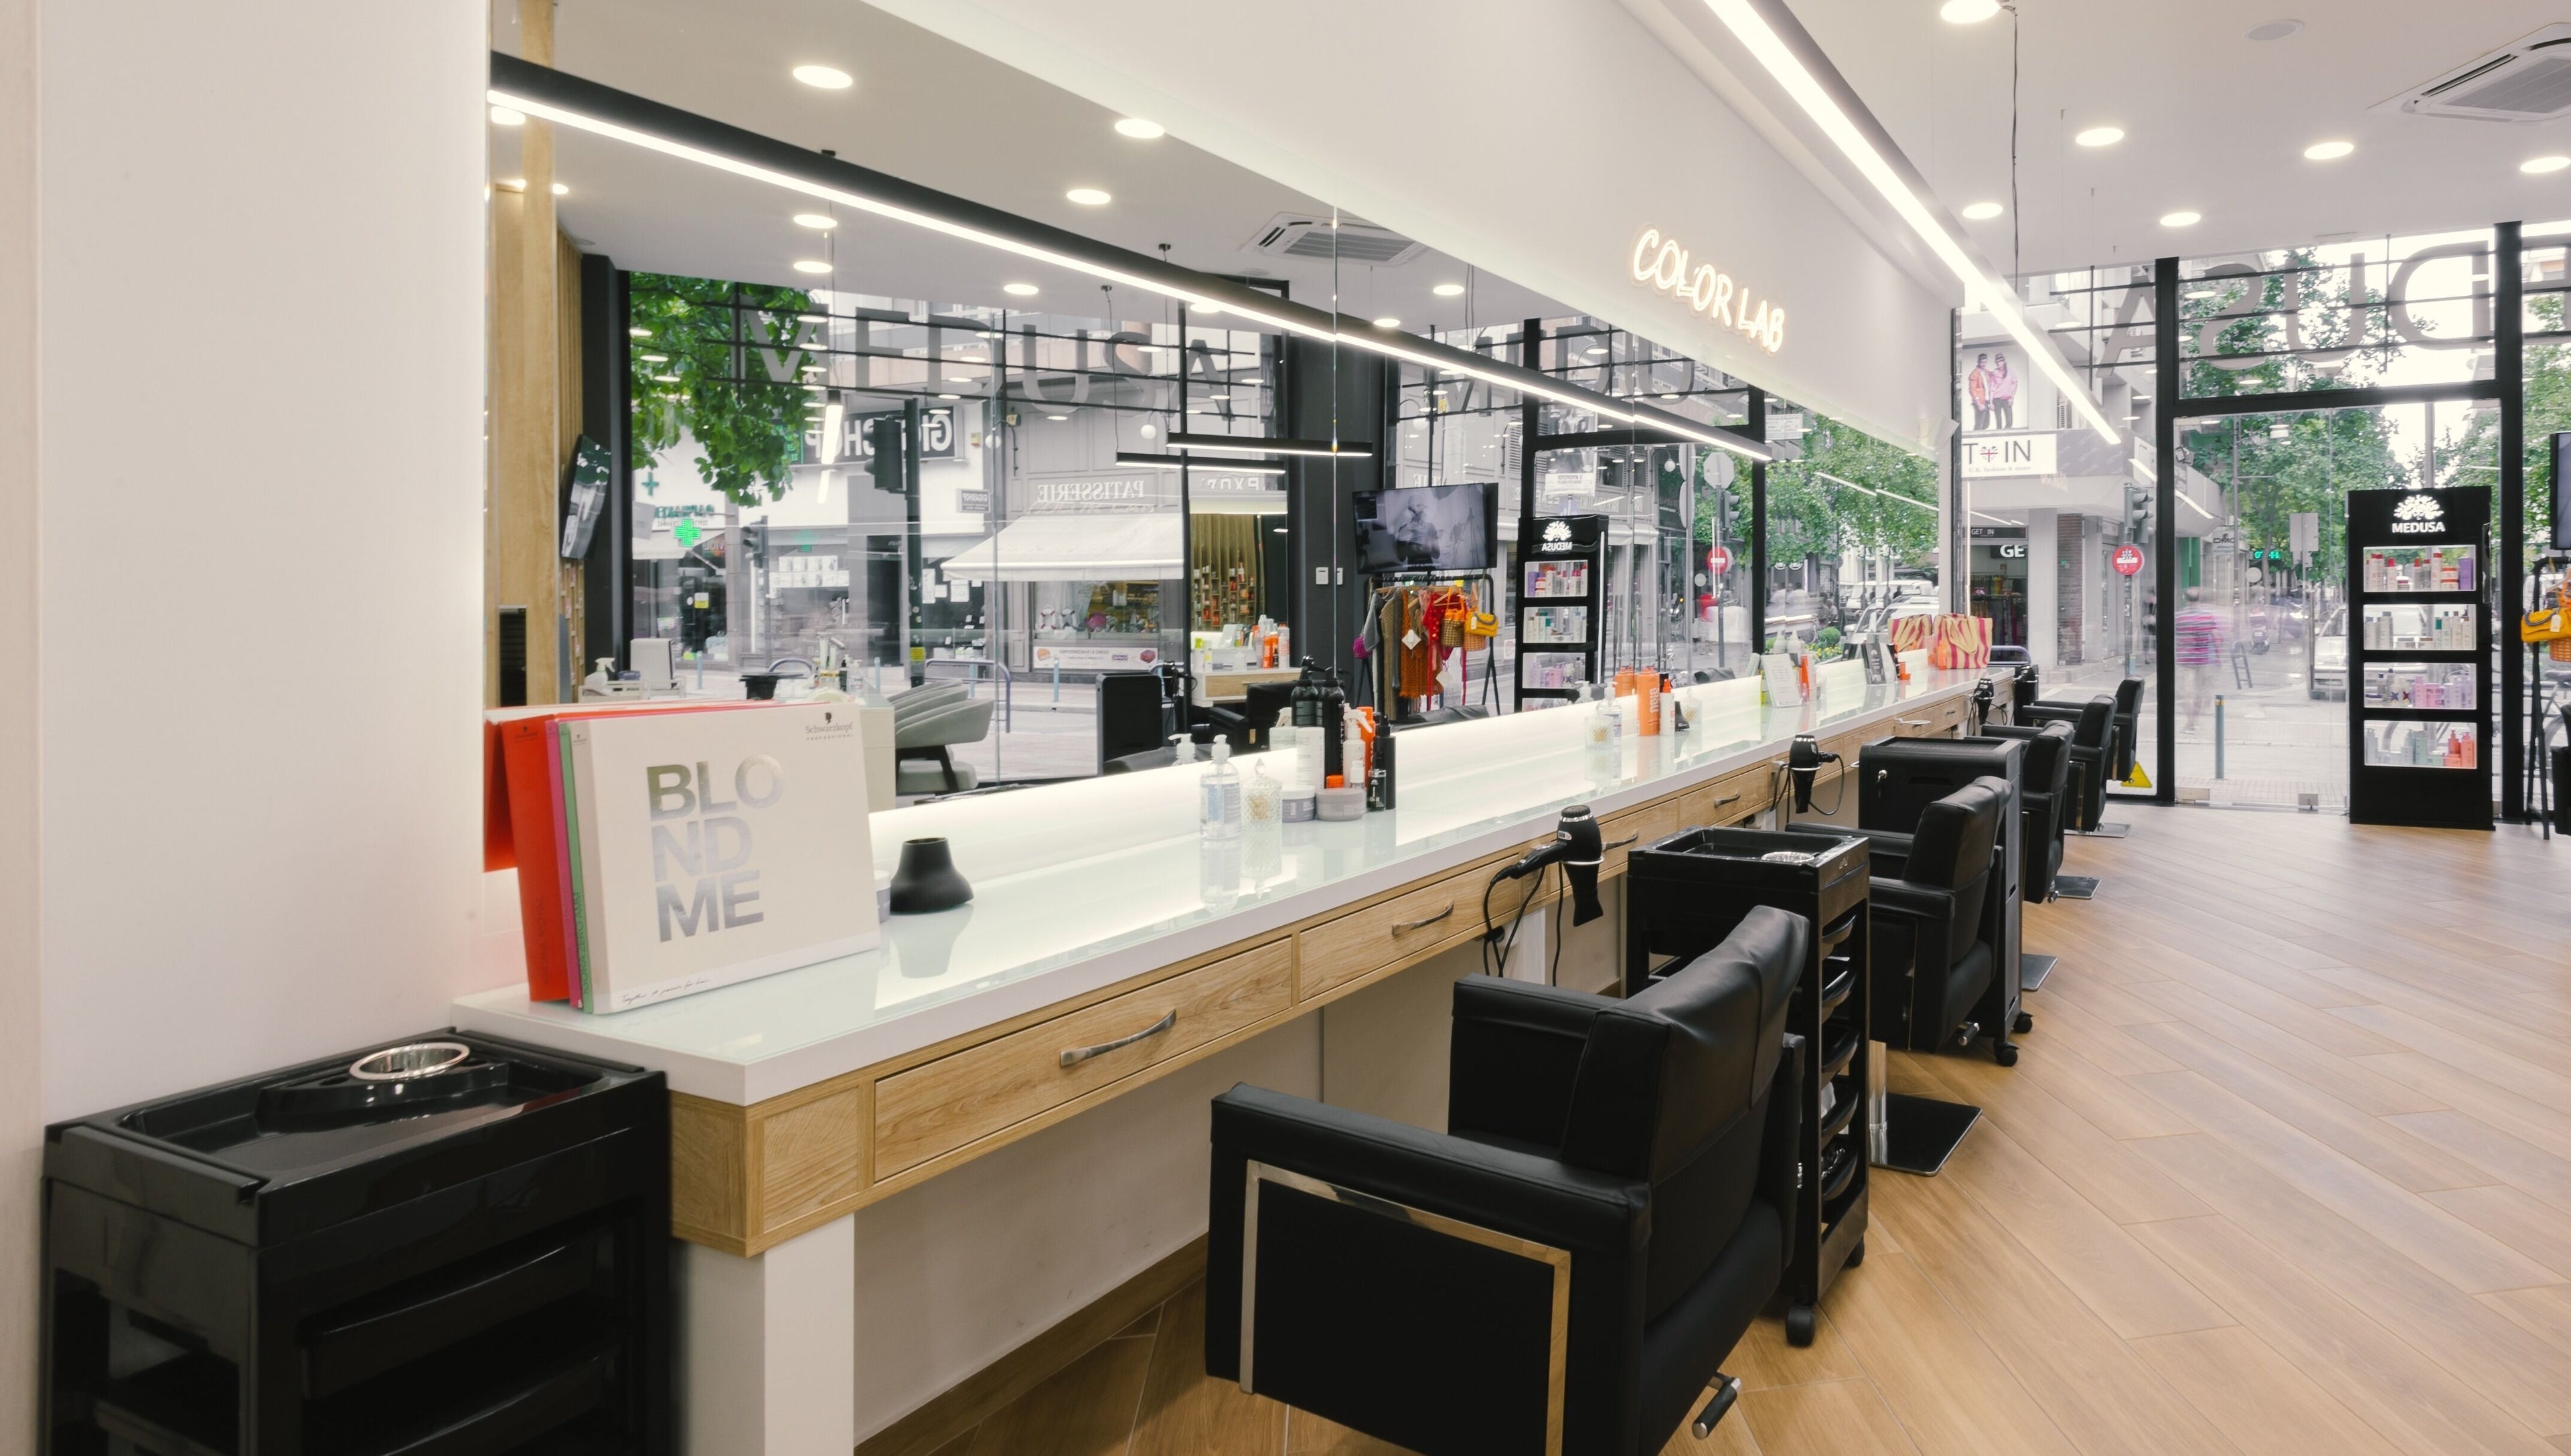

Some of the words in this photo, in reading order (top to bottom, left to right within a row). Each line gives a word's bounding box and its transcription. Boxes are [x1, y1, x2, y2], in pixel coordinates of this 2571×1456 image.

[1633, 228, 1733, 327] COLOR
[1737, 287, 1785, 353] LAB
[2005, 439, 2031, 463] IN
[2392, 521, 2446, 533] MEDUSA
[2000, 544, 2025, 558] GE
[805, 722, 852, 734] Schwarzkopf
[646, 754, 785, 822] BLO
[651, 816, 753, 882] ND
[655, 870, 765, 943] ME
